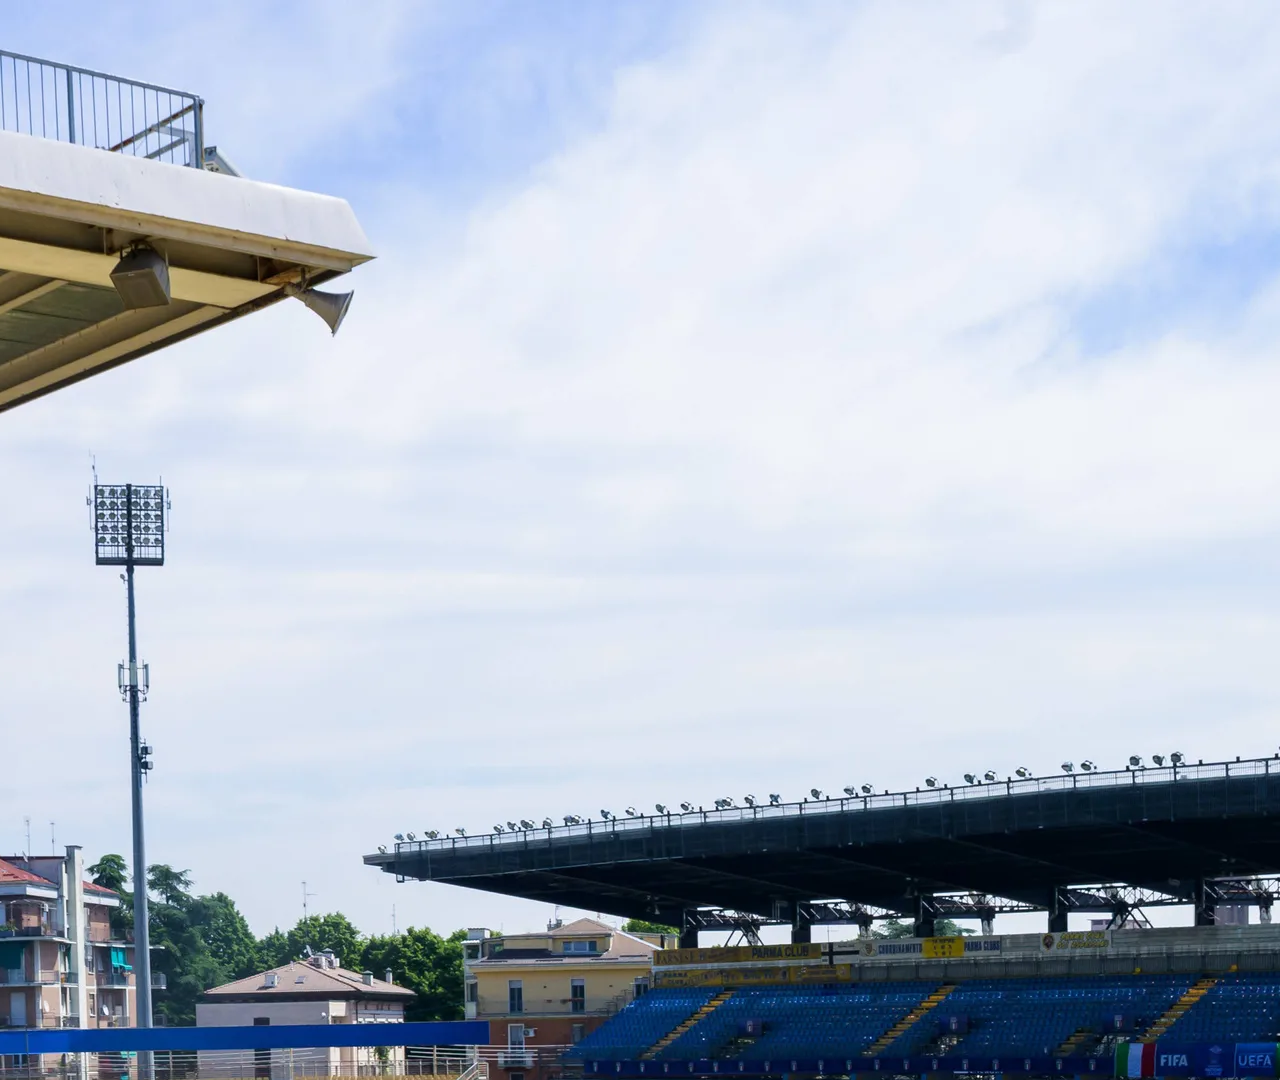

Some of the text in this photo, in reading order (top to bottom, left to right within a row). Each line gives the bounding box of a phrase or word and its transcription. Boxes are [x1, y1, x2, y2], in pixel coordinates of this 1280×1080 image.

[751, 946, 782, 958] PARMA
[784, 945, 809, 957] CLUB
[1160, 1054, 1188, 1067] FIFA
[1238, 1054, 1272, 1067] UEFA
